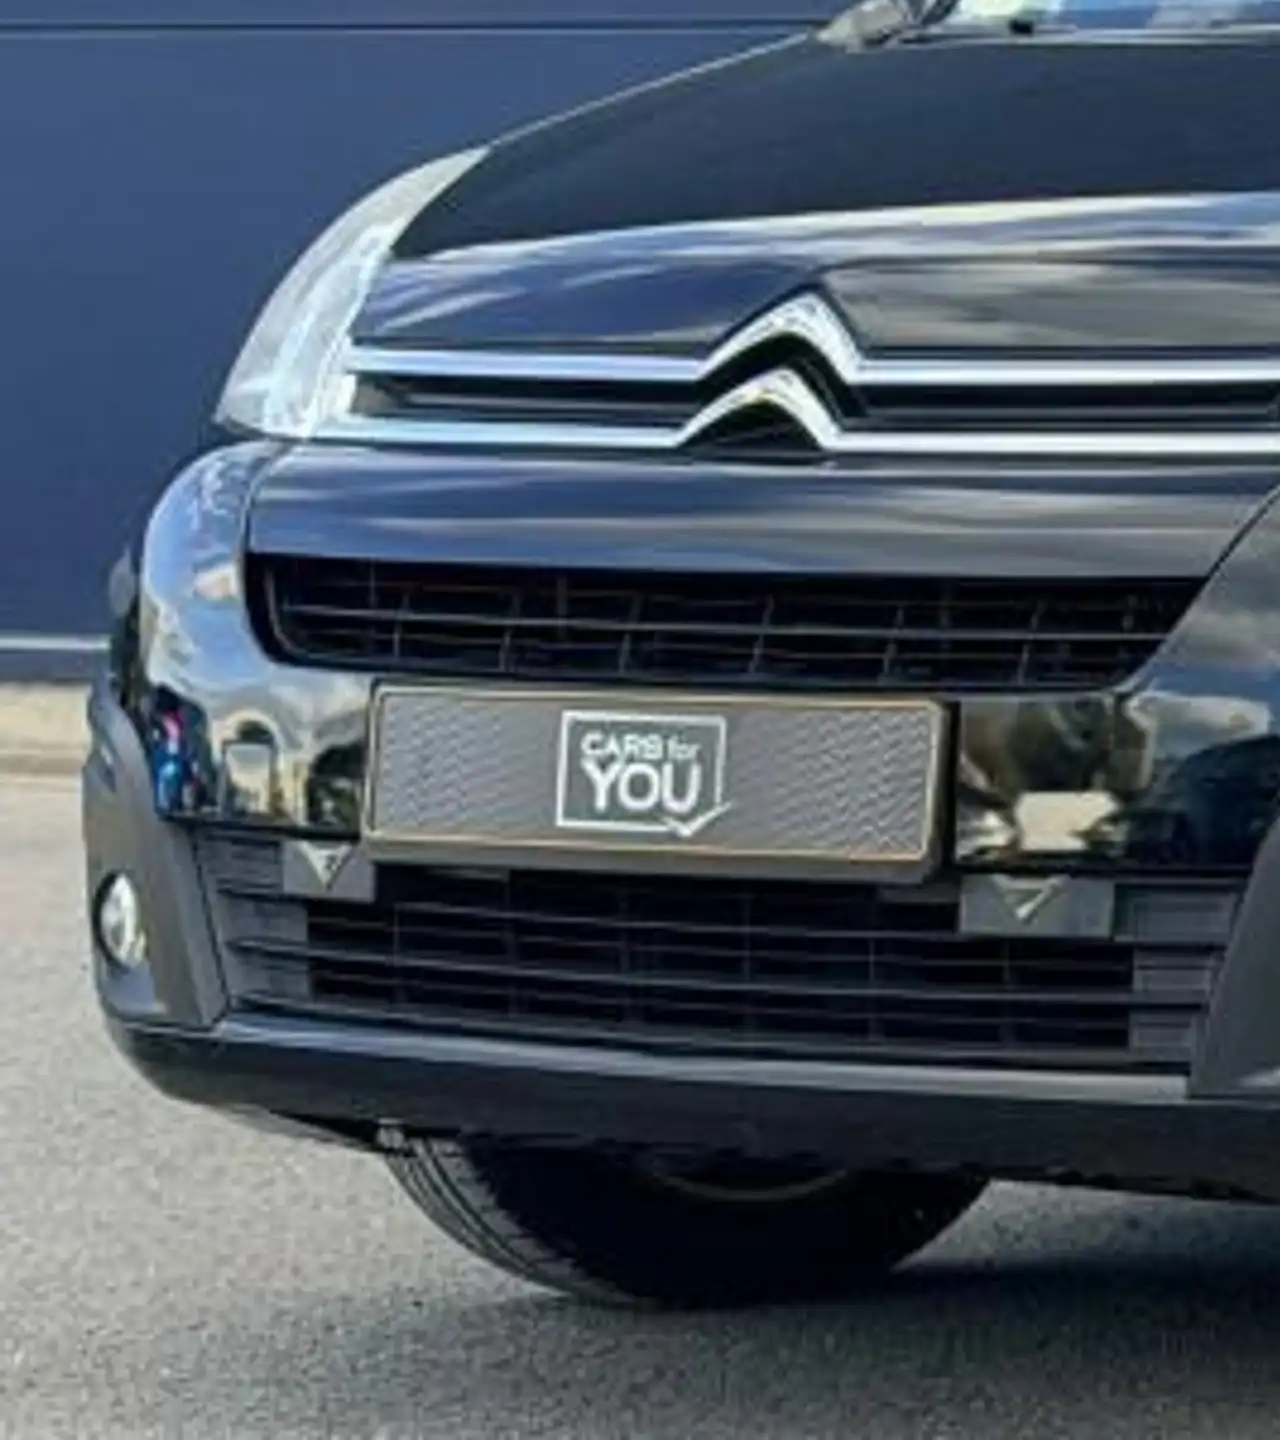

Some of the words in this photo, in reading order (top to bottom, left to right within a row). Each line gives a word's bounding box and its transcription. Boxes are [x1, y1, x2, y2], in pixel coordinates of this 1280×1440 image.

[581, 731, 663, 759] CARS
[667, 735, 700, 761] for
[580, 757, 701, 813] YOU
